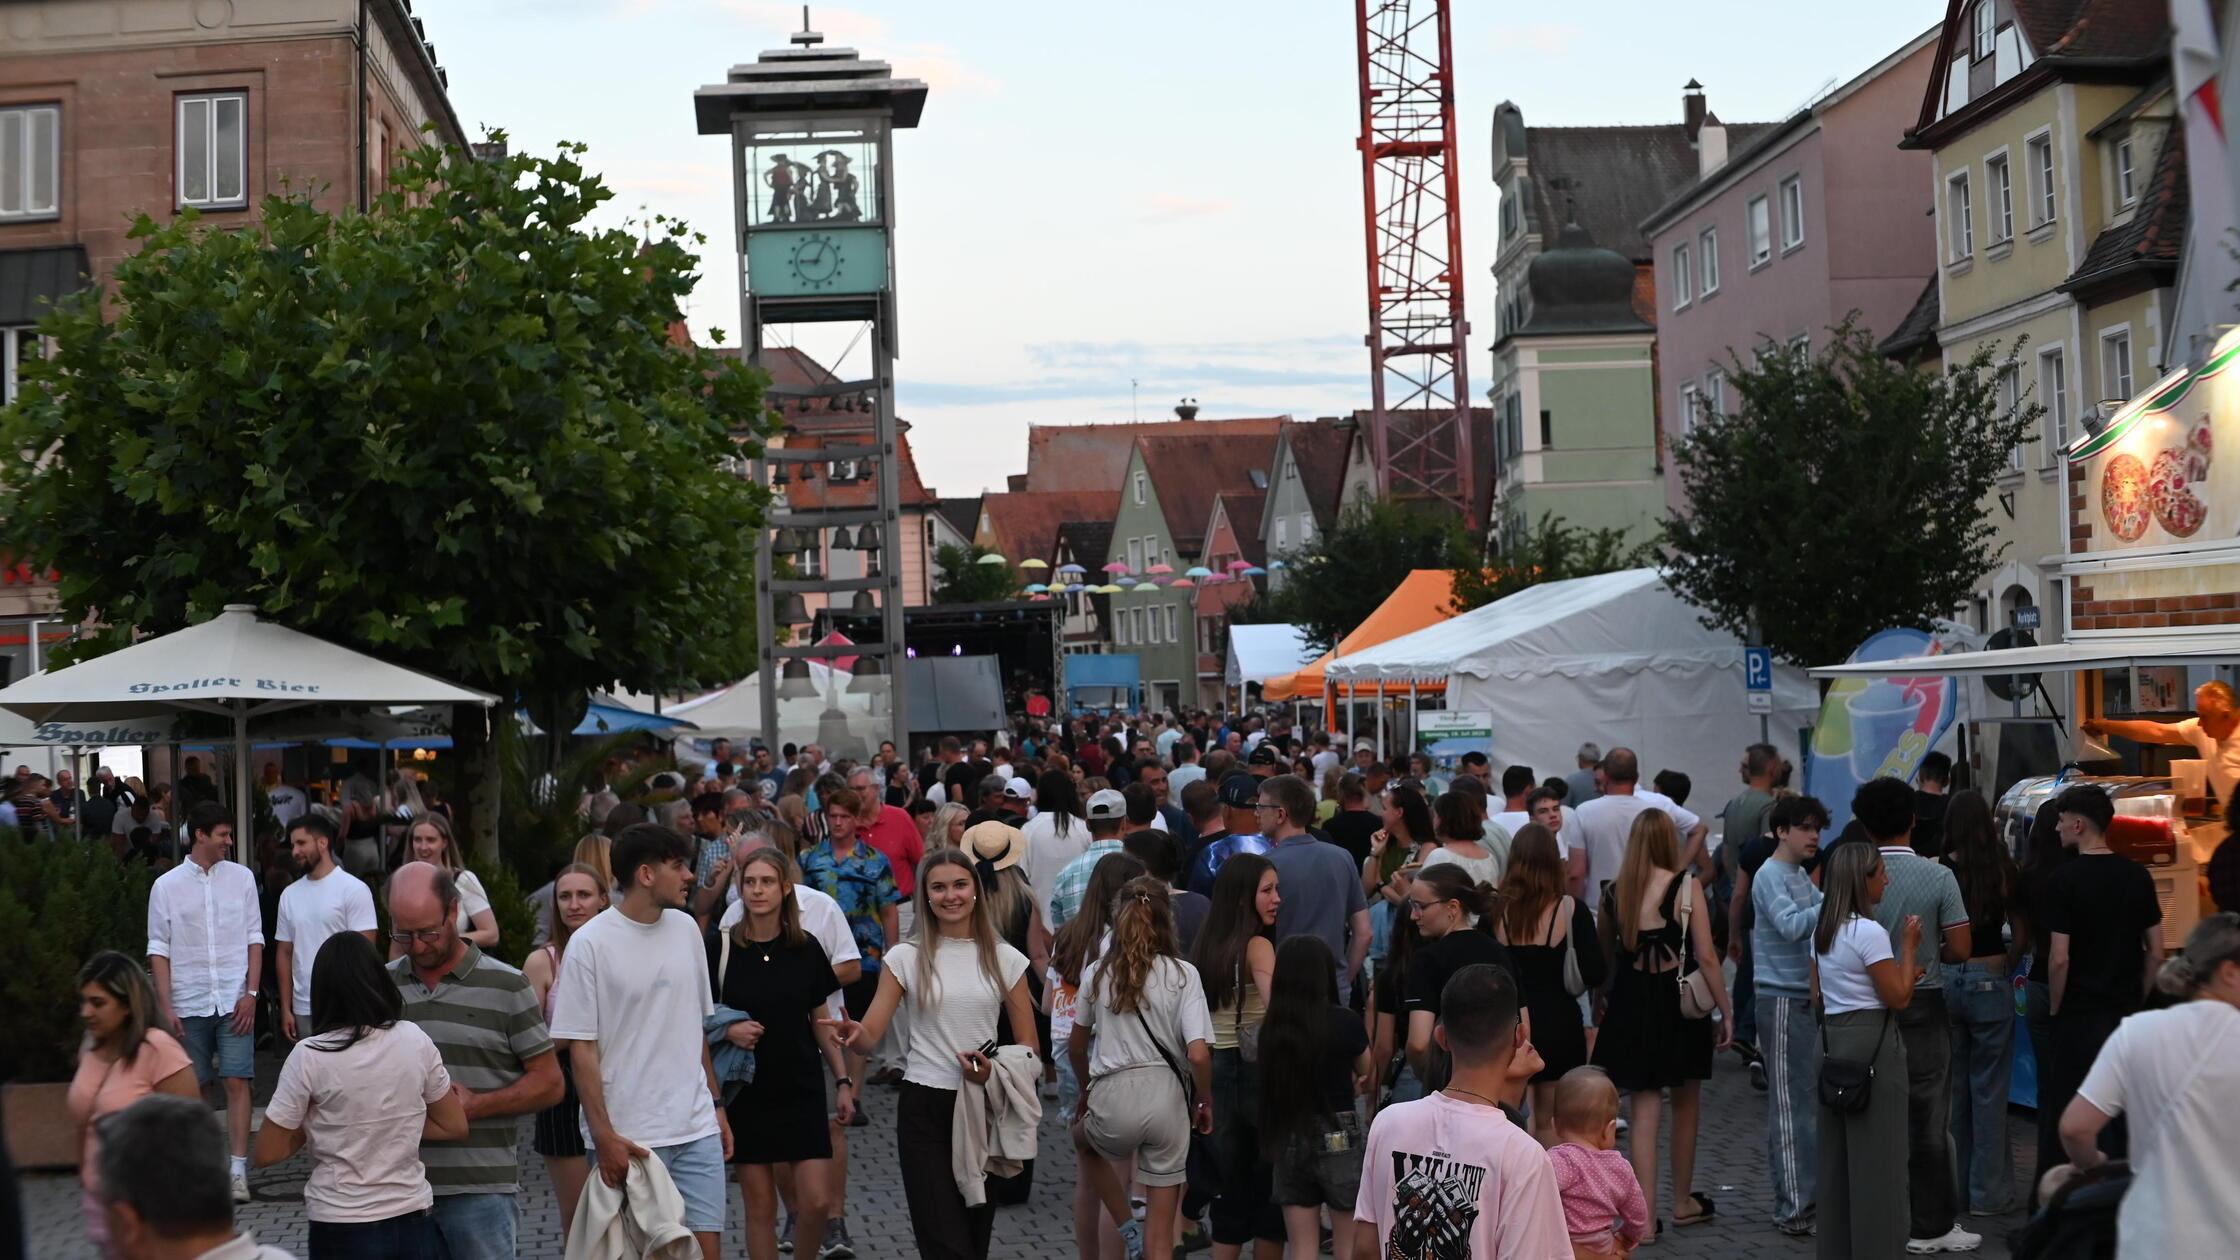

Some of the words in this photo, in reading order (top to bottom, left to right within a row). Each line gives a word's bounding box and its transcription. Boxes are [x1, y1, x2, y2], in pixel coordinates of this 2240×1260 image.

[1749, 653, 1763, 685] P
[129, 677, 241, 694] Spalter
[256, 678, 320, 693] Bier
[33, 723, 161, 743] Spalter
